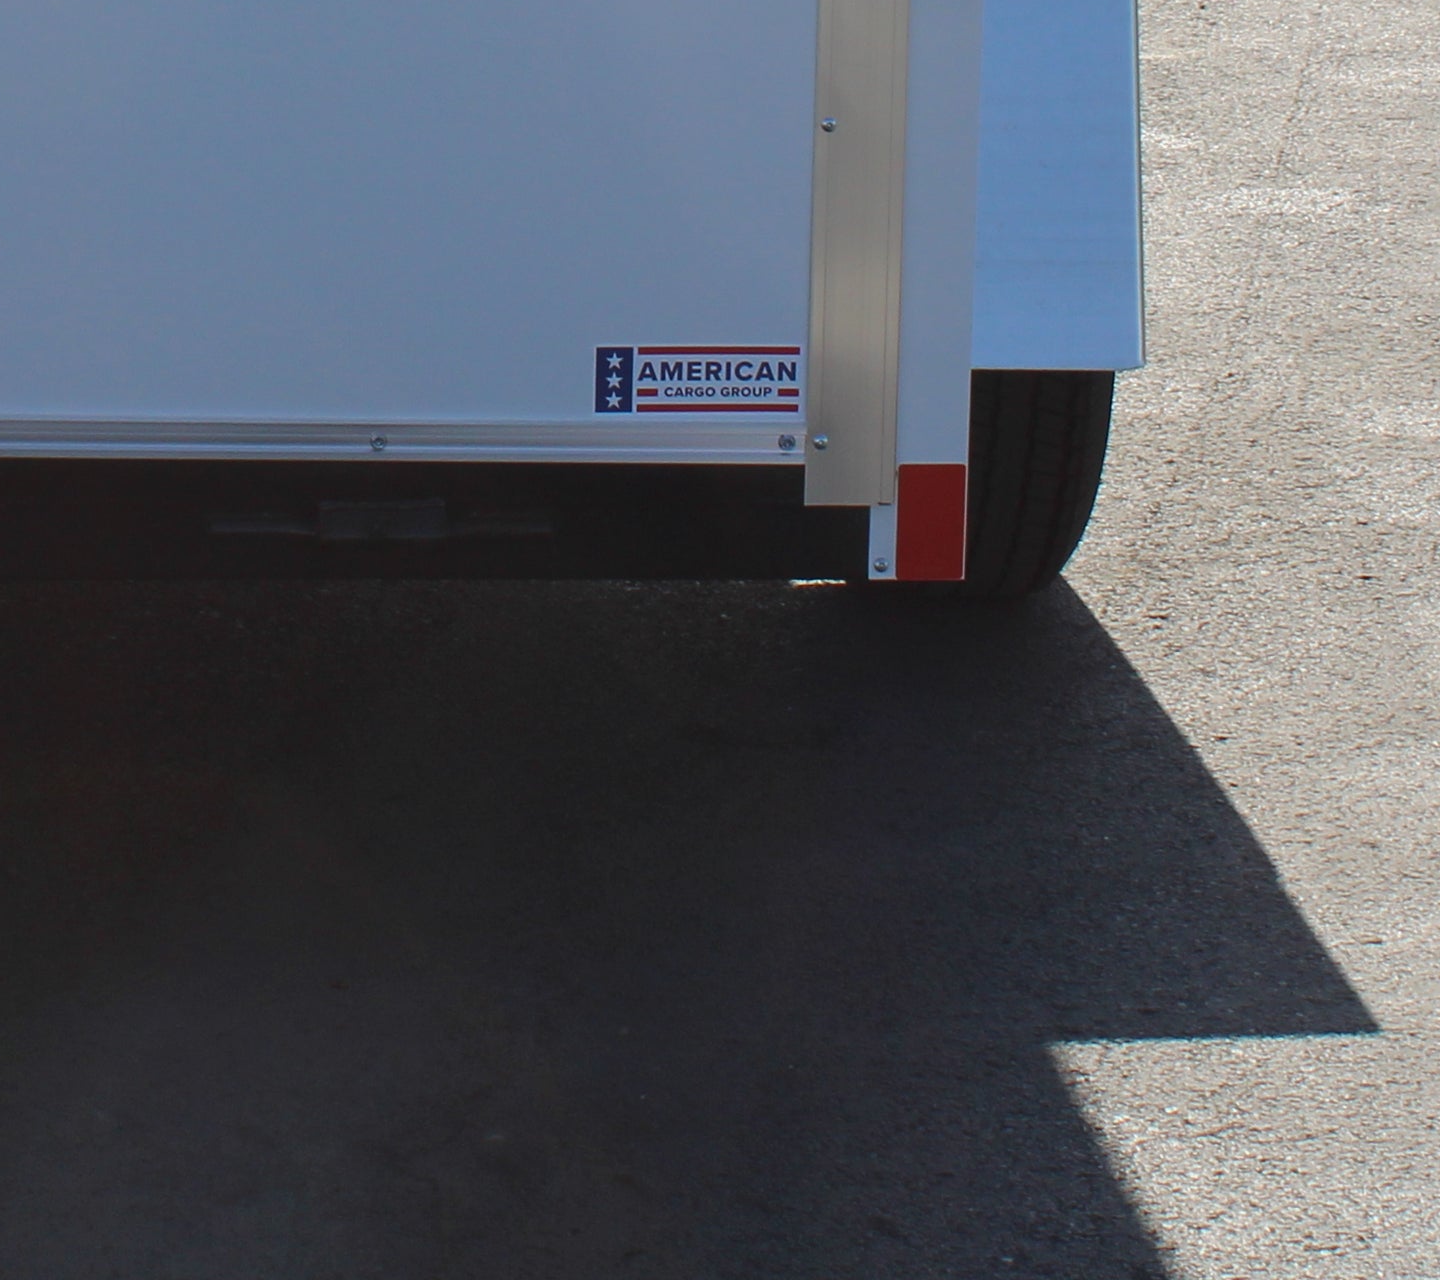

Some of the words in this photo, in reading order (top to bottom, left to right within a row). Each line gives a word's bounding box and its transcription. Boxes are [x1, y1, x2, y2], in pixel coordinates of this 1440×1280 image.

[636, 360, 797, 382] AMERICAN
[664, 386, 716, 397] CARGO
[720, 386, 772, 398] GROUP
